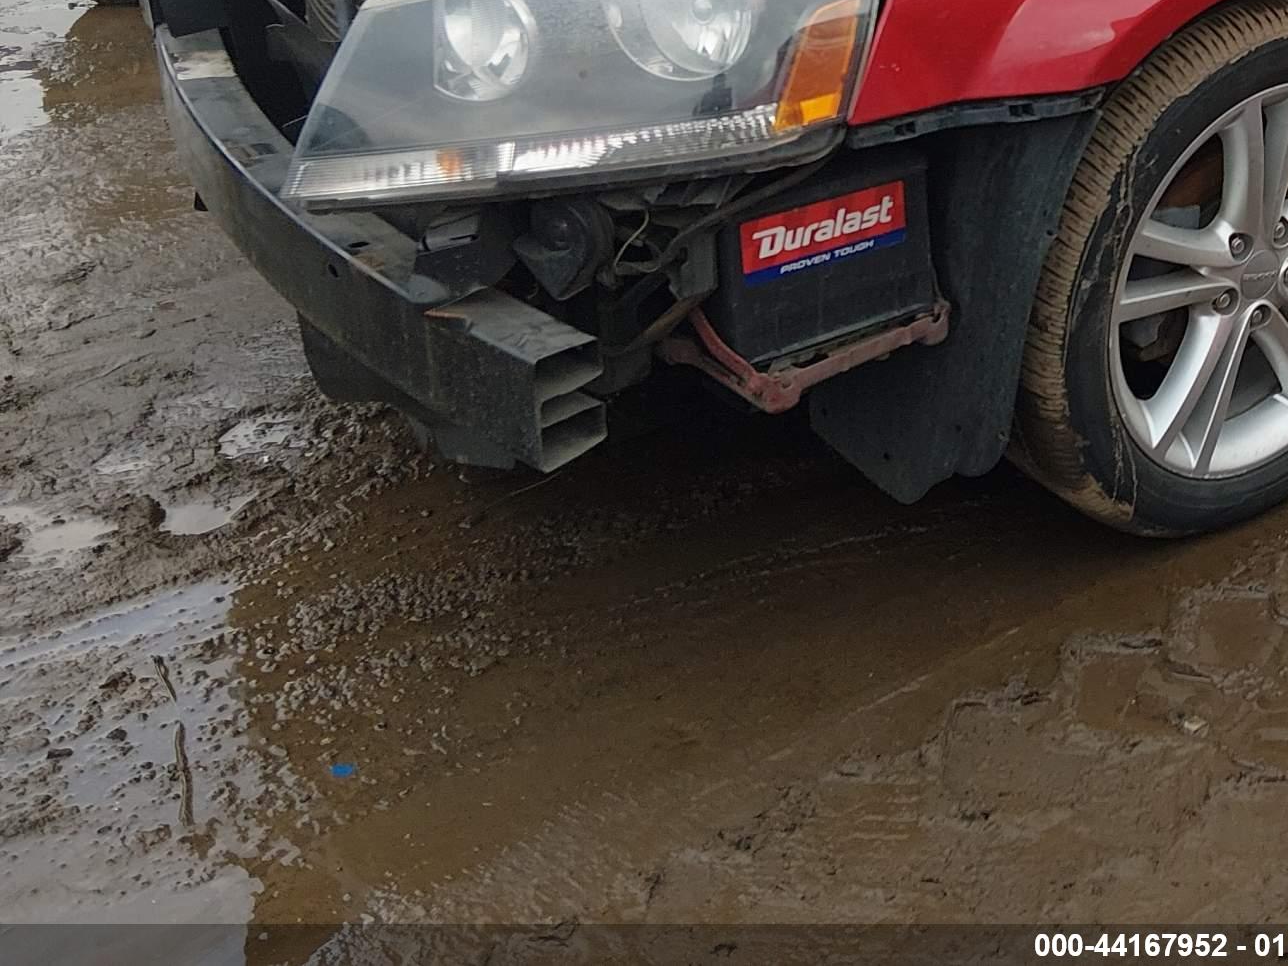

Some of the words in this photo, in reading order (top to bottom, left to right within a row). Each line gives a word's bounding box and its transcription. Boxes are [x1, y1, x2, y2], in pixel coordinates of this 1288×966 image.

[751, 195, 894, 260] Duralast
[779, 251, 832, 275] PROVEN
[833, 238, 875, 259] TOUGH
